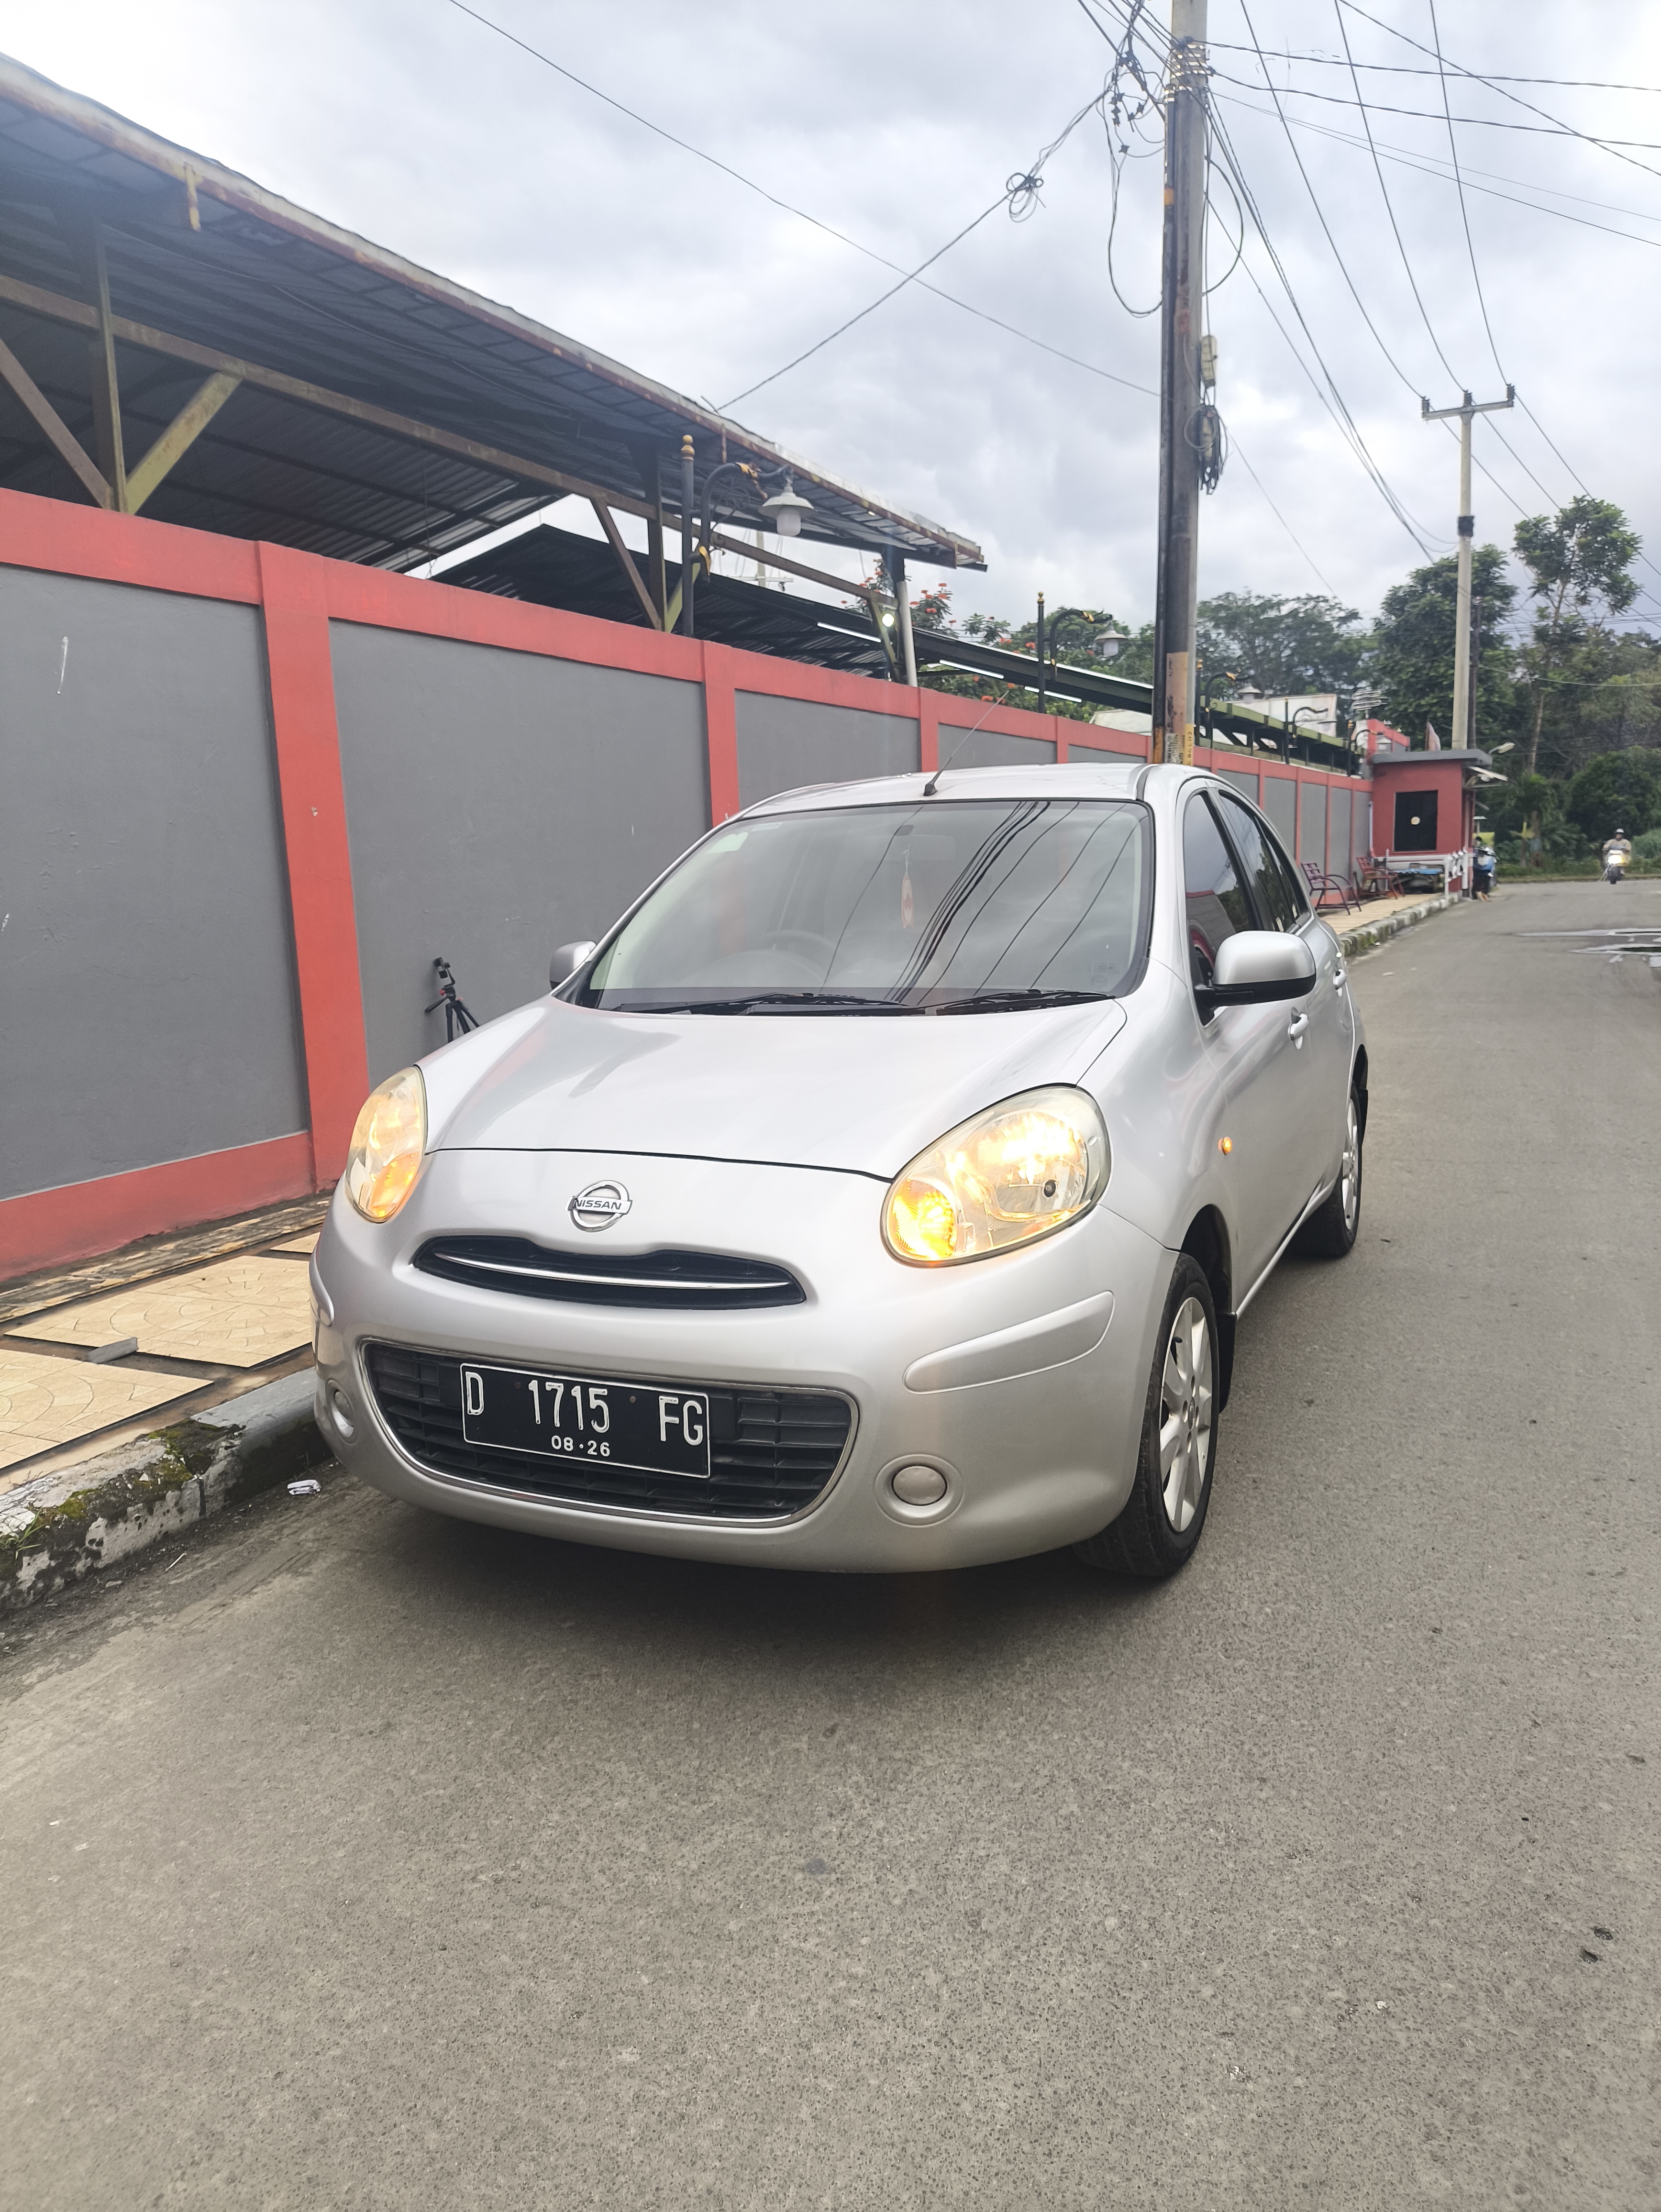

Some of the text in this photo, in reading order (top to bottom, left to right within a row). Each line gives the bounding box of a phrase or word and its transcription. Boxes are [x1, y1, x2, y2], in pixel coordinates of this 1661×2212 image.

[572, 1199, 622, 1210] NISSAN
[465, 1371, 703, 1446] D 1715 FG
